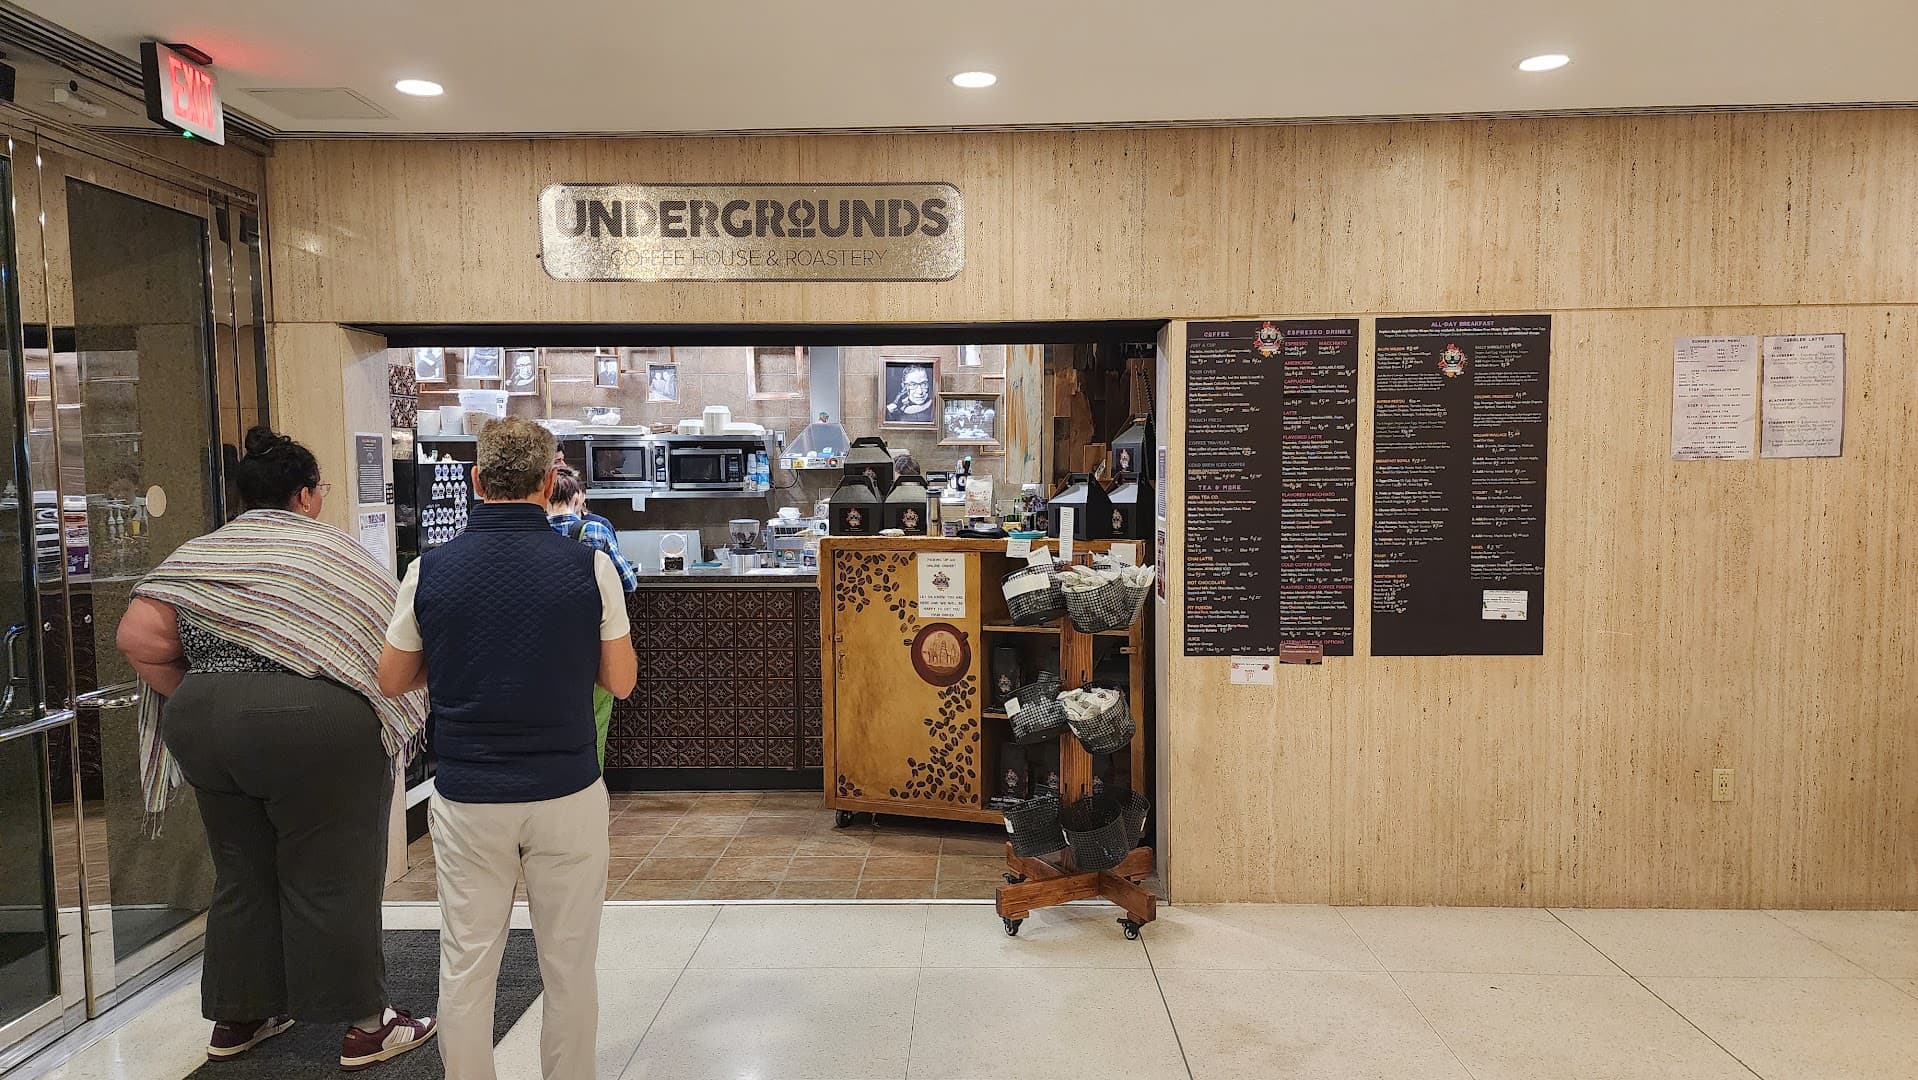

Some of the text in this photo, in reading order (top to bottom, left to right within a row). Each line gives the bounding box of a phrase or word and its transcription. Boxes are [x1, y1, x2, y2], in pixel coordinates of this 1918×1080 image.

[168, 55, 215, 132] EXIT
[555, 198, 950, 239] UNDERGROUNDS
[609, 248, 888, 267] COFFEE HOUSE & ROASTERY
